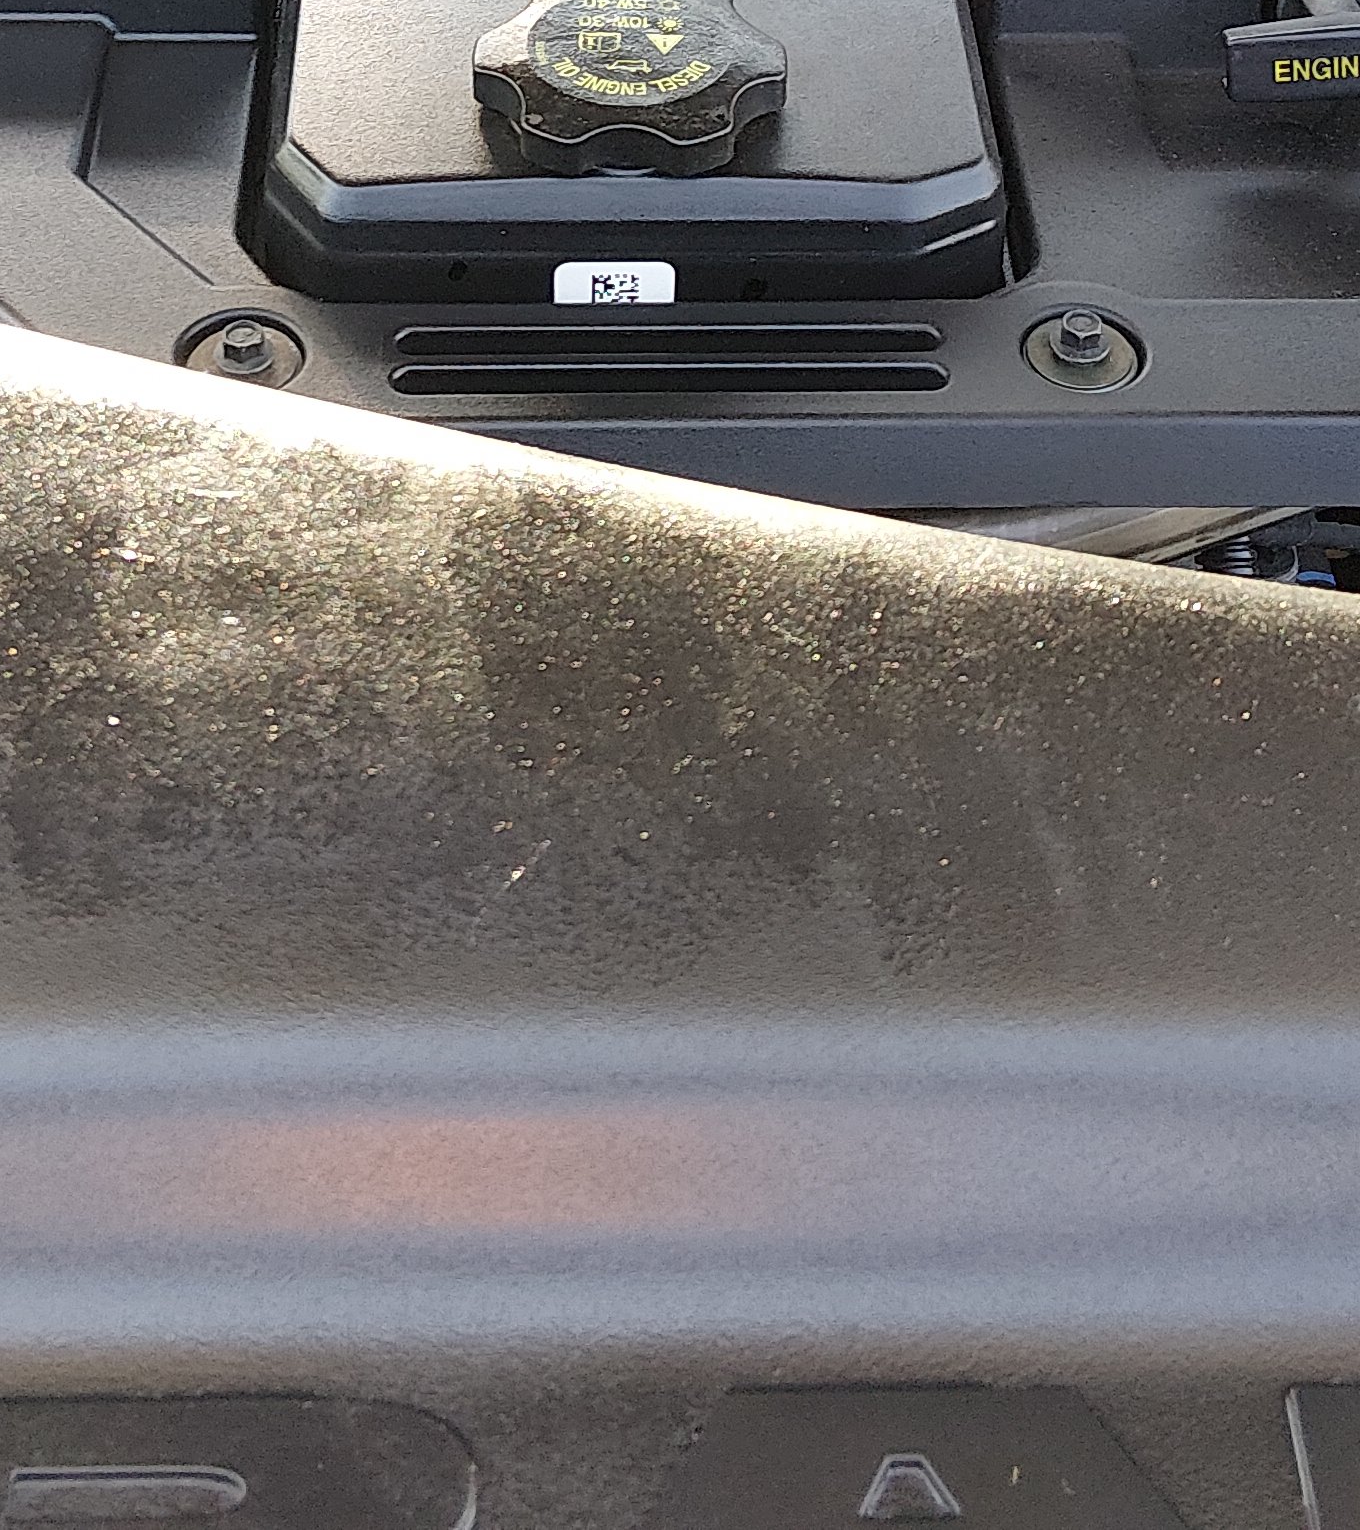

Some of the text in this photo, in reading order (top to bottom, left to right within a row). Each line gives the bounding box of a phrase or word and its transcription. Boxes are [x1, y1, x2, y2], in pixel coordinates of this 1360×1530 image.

[577, 15, 652, 30] 10W-30
[552, 56, 712, 96] DIESEL ENGINE OIL
